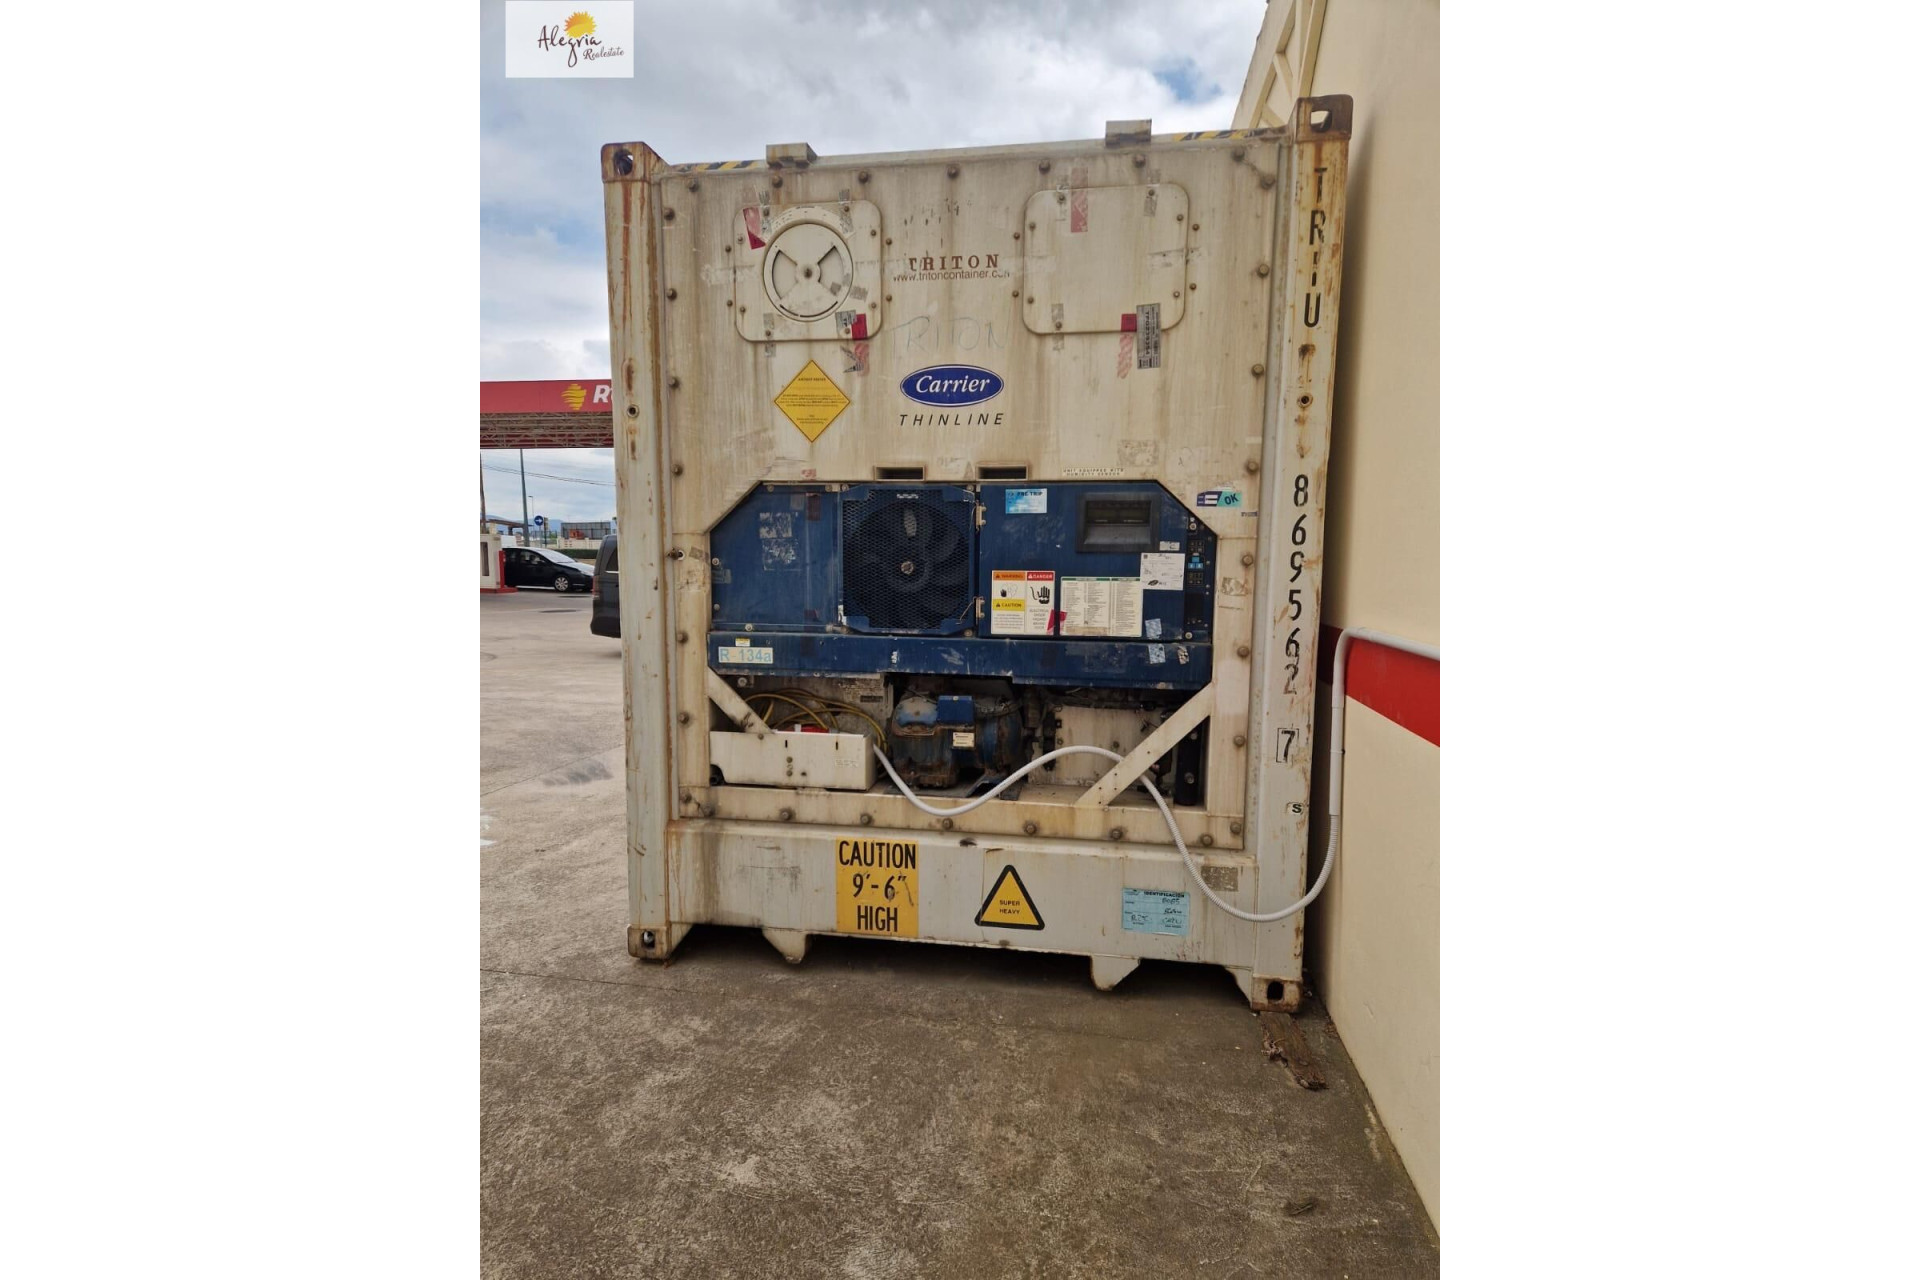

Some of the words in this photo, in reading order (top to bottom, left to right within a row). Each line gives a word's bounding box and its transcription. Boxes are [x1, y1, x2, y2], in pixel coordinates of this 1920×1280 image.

[1304, 167, 1328, 328] TRIU
[909, 254, 999, 272] TRITON
[916, 375, 990, 393] Carrier
[900, 413, 1004, 426] THINLINE
[1224, 493, 1239, 505] OK
[1292, 803, 1302, 813] S
[839, 840, 916, 869] CAUTION
[857, 905, 898, 932] HIGH
